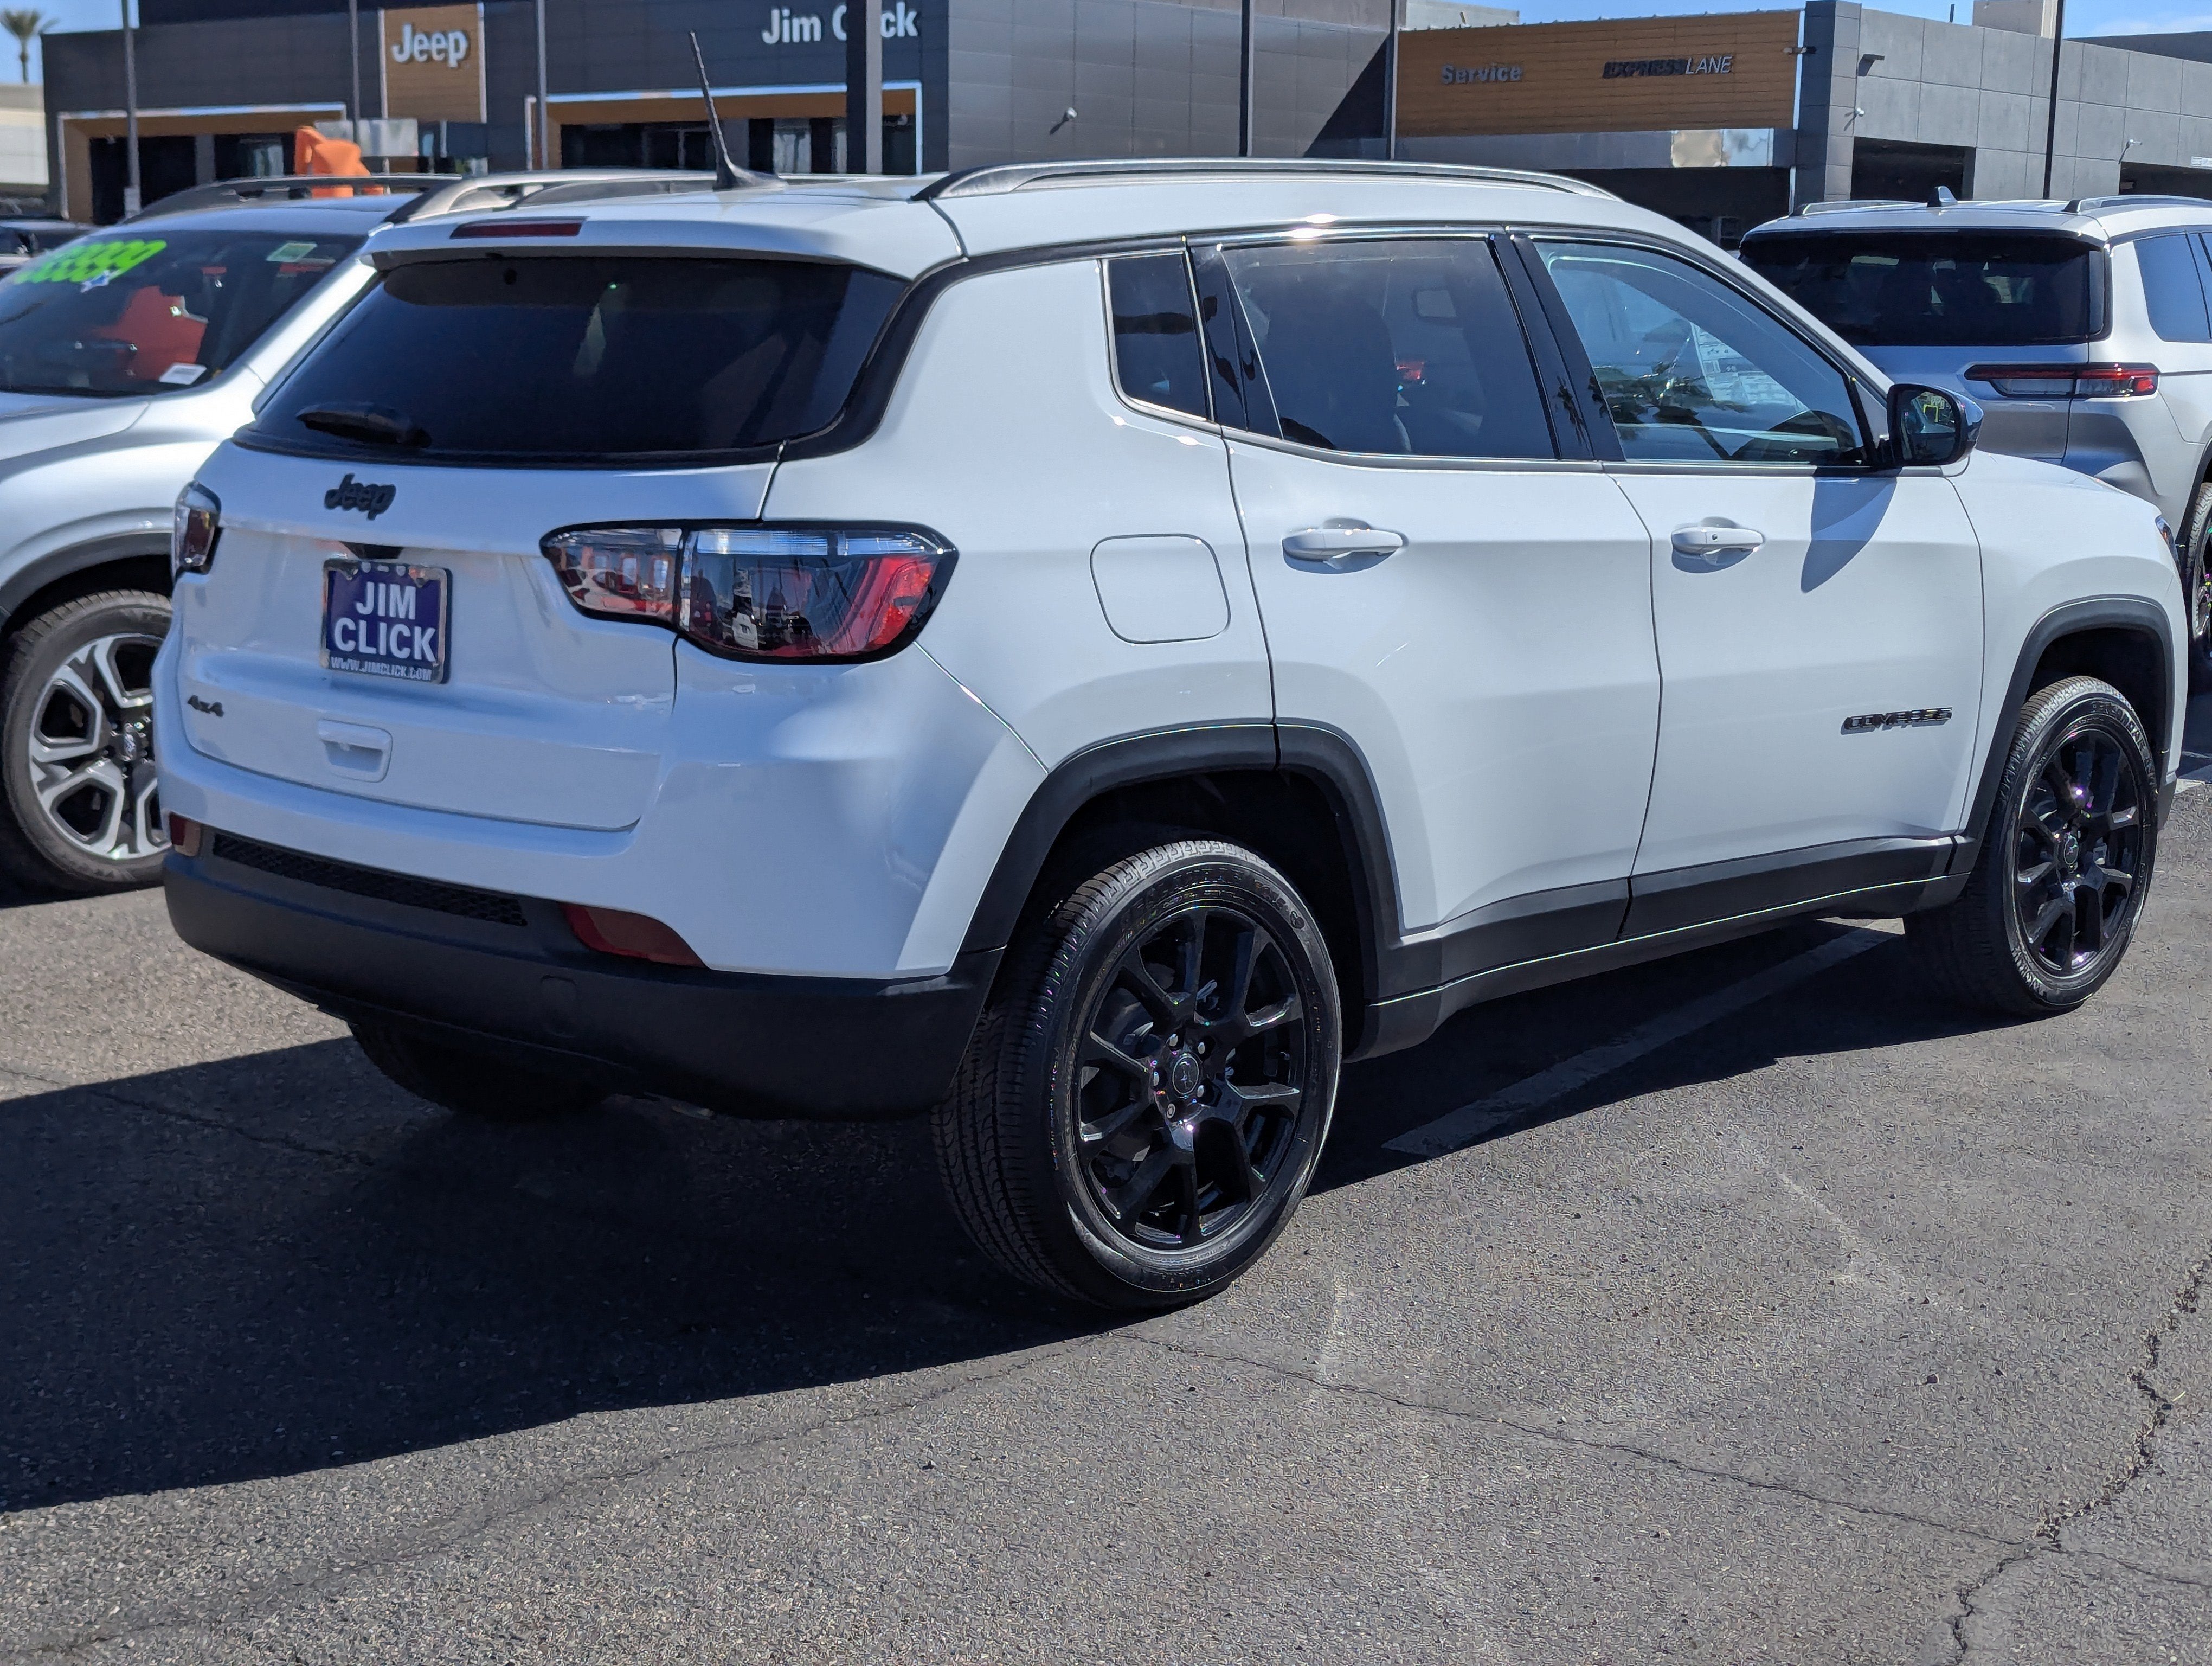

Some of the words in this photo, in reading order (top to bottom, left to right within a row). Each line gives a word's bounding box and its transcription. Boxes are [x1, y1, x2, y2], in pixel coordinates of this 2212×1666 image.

[761, 8, 821, 44] Jim
[832, 1, 918, 41] Cck
[390, 23, 468, 68] Jeep
[1685, 55, 1733, 75] LANE
[1441, 63, 1523, 84] Service
[324, 473, 397, 521] Jeep
[356, 581, 416, 620] JIM
[334, 617, 436, 662] CLICK
[330, 656, 433, 681] WWW.JIMCLICK.COM
